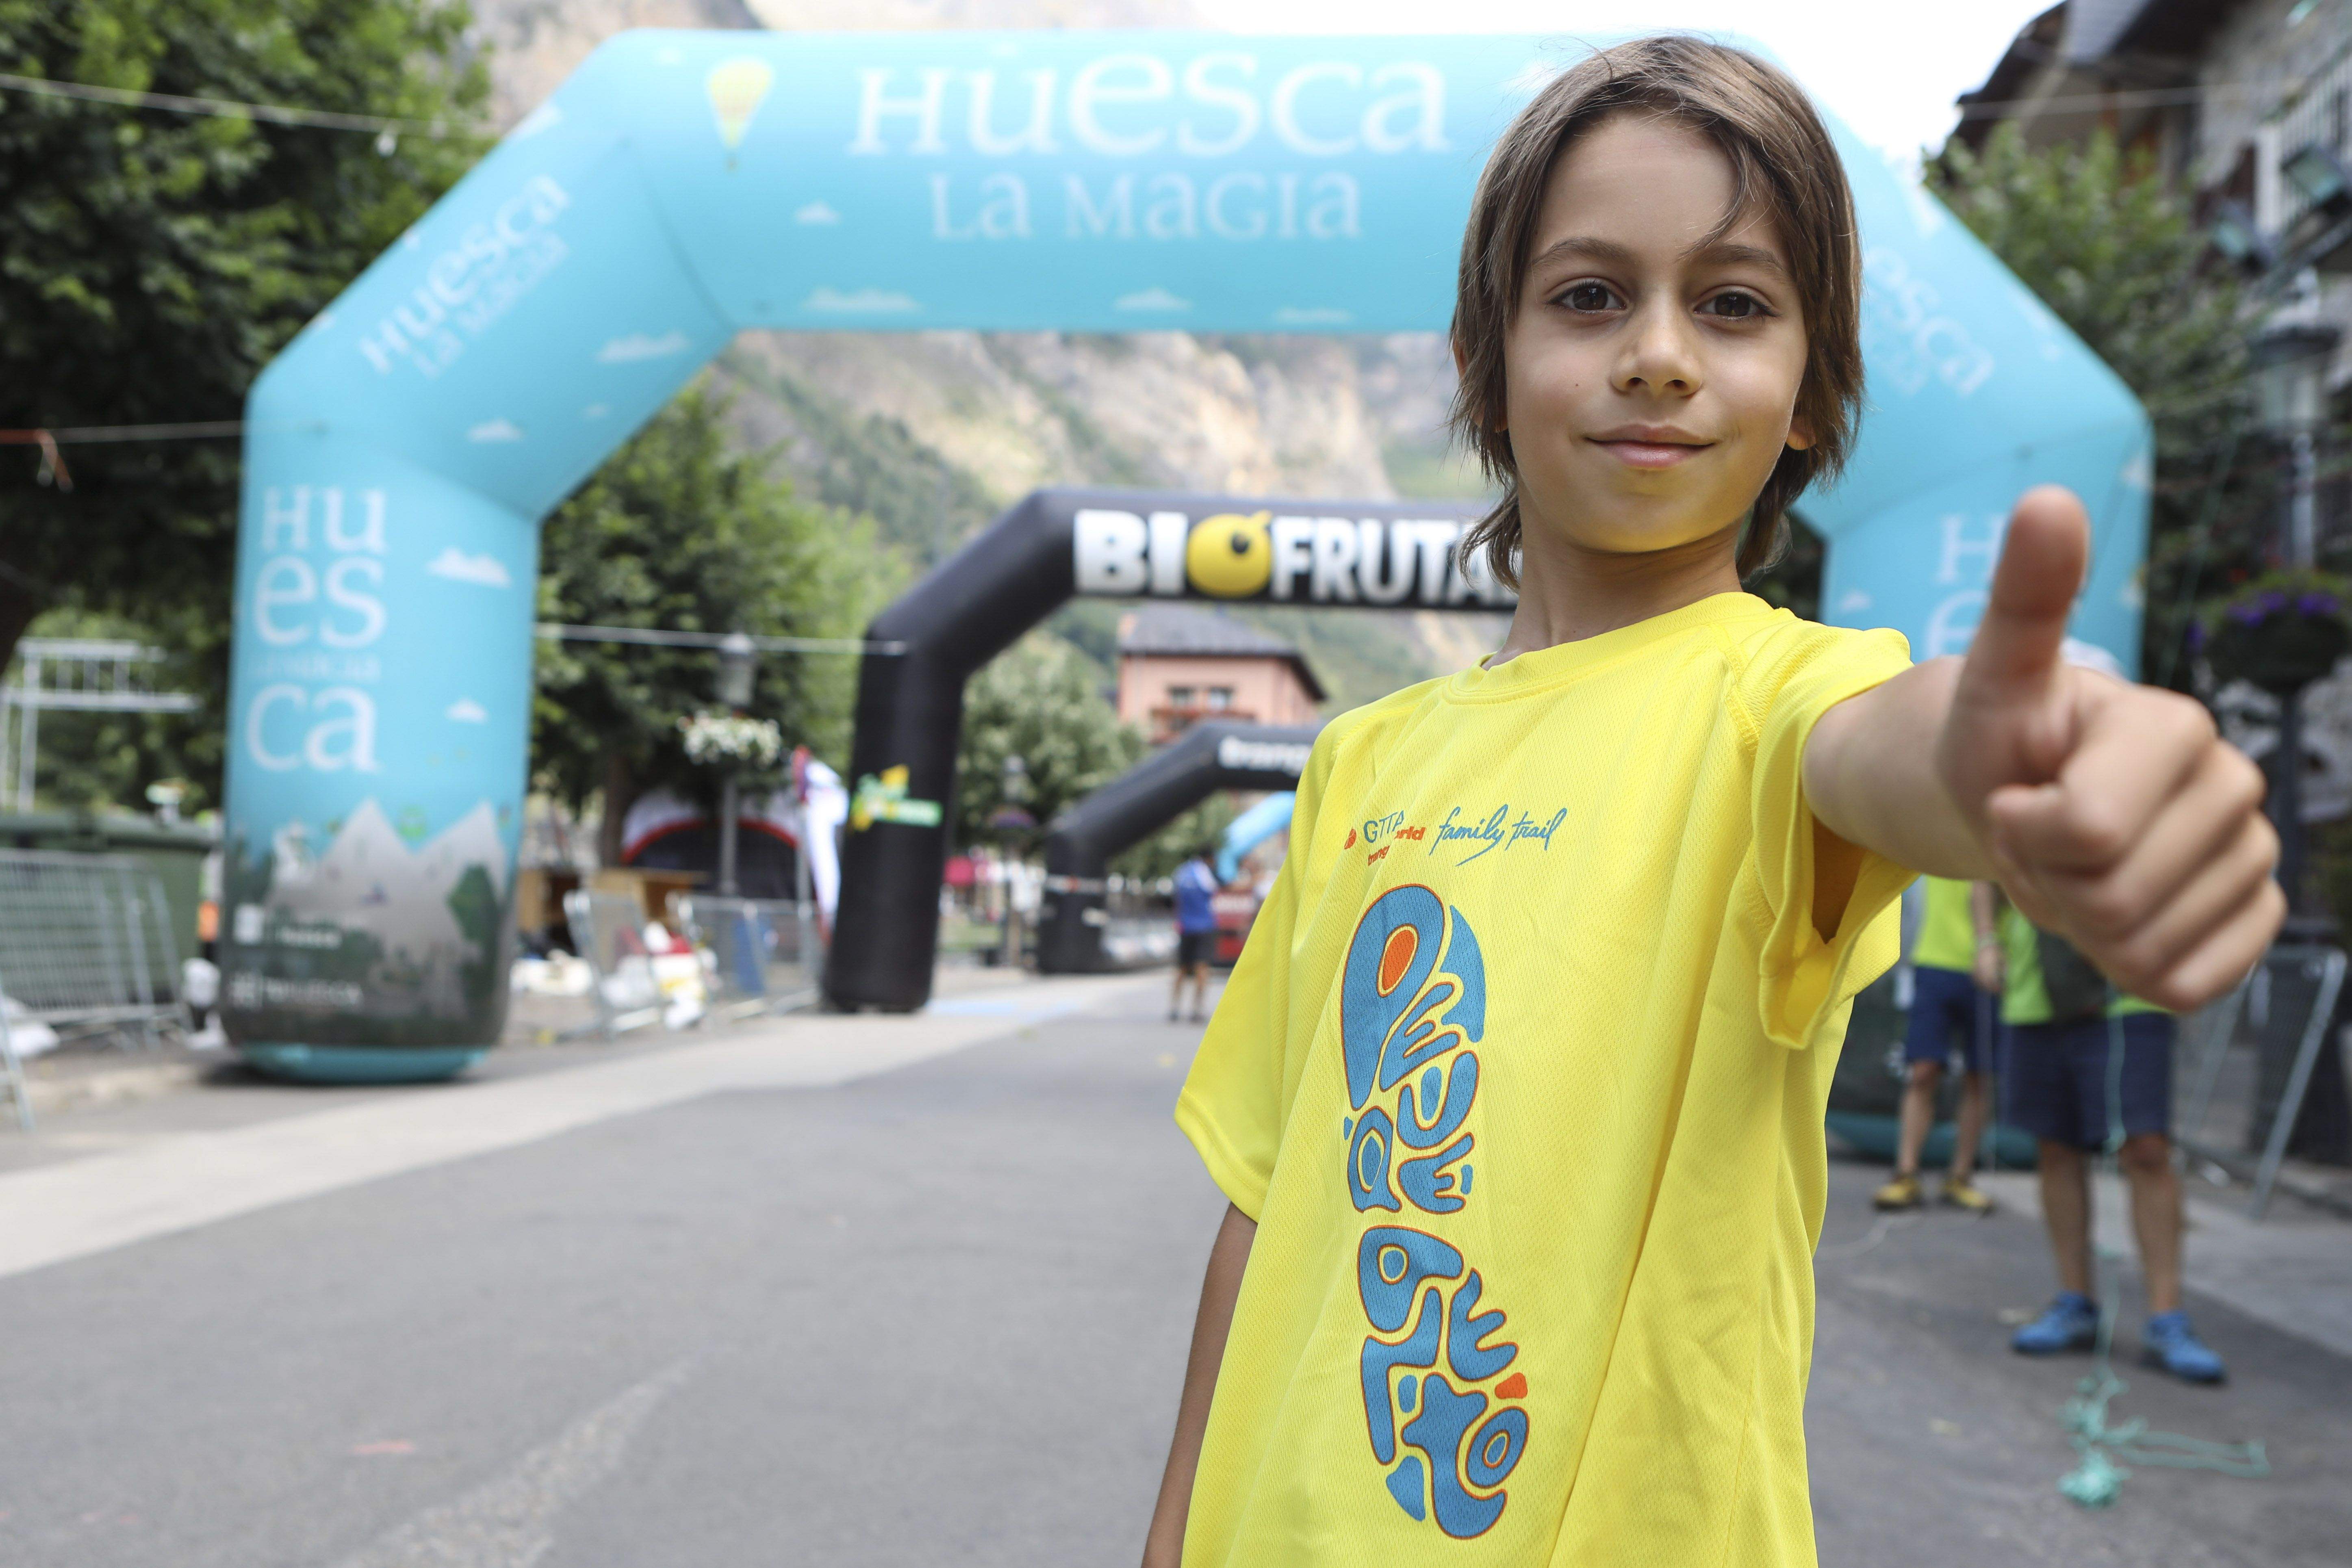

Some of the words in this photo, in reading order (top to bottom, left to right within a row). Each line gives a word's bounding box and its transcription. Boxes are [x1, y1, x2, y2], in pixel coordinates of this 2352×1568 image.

[848, 48, 1450, 158] Huesca
[1864, 245, 1995, 398] esca
[253, 554, 388, 649] es
[1073, 508, 1521, 605] BIOFRUTA
[247, 682, 384, 774] ca
[1428, 804, 1509, 867] family
[1504, 807, 1568, 851] trail
